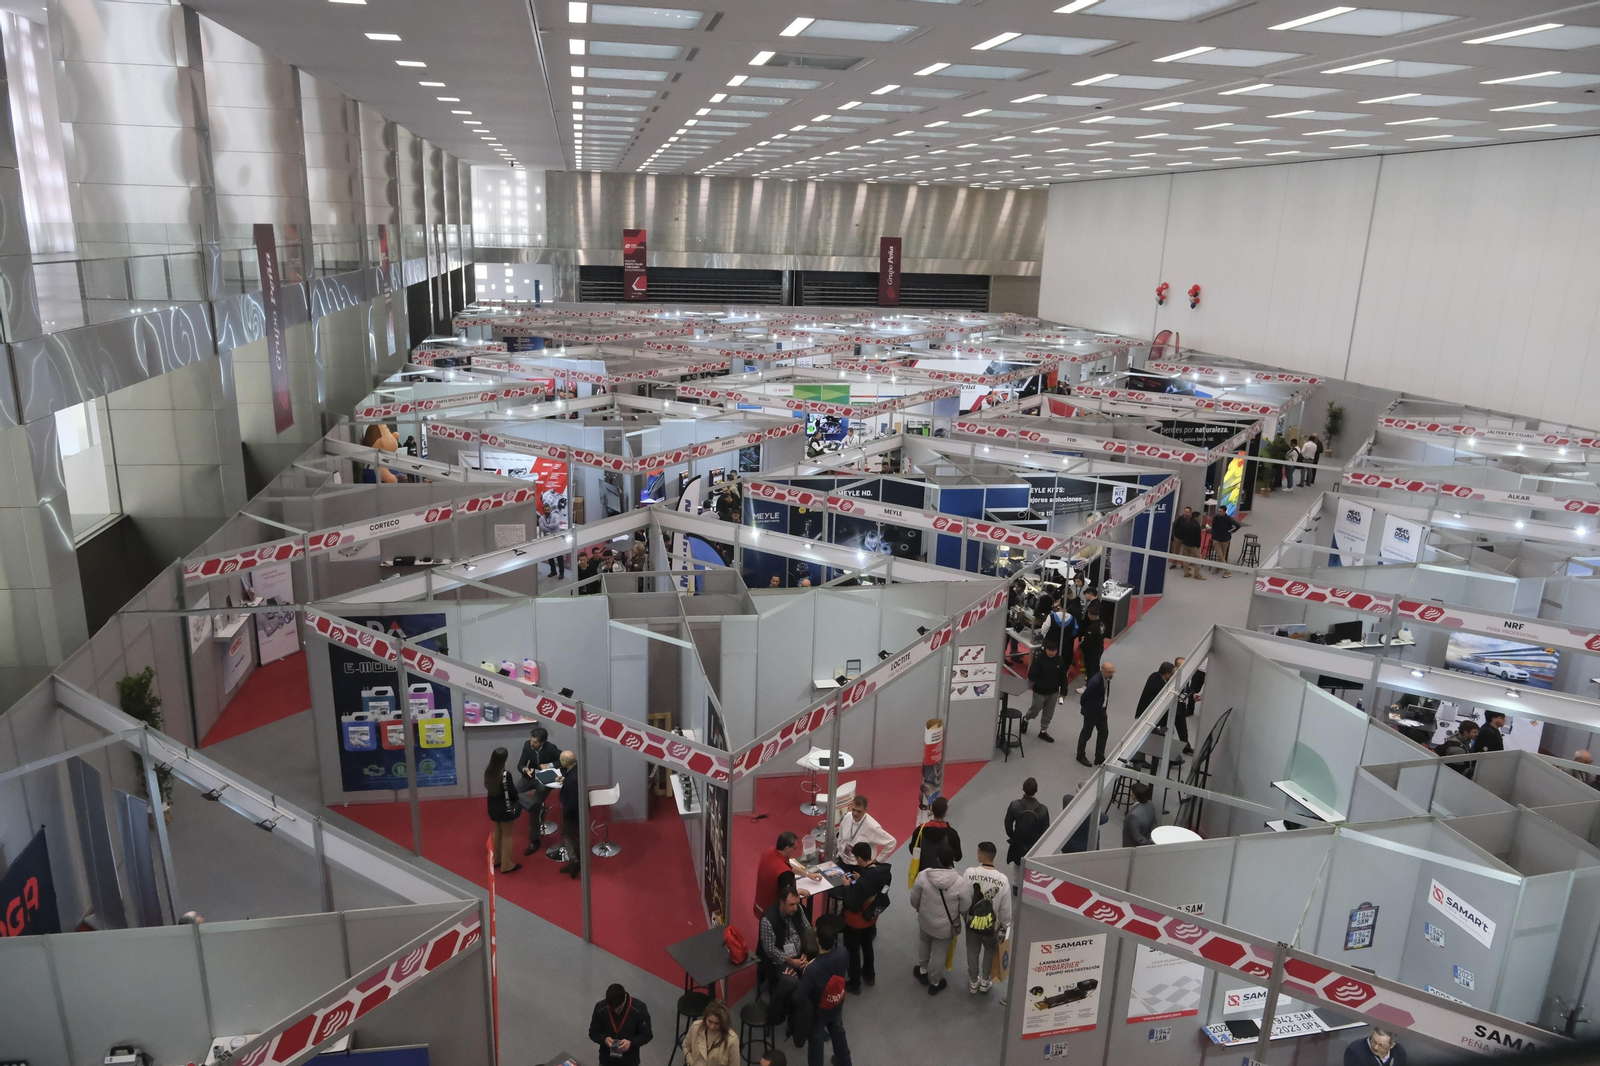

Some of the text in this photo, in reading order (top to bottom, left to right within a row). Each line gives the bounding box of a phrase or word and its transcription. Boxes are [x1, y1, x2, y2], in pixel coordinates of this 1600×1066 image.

[266, 252, 282, 370] Grupo Peña
[503, 439, 527, 448] TECNODIESEL
[370, 519, 399, 531] CORTECO
[1504, 621, 1525, 630] NRF
[1502, 629, 1539, 639] PROFESIONAL
[344, 661, 397, 673] E-MOB
[891, 652, 910, 671] LOCTITE
[474, 675, 494, 689] IADA
[969, 875, 1004, 887] MUTATION
[1186, 904, 1203, 913] SAM
[1430, 926, 1444, 938] 1942
[1430, 932, 1440, 942] SAM
[1054, 939, 1094, 950] SAMAR't
[1038, 961, 1080, 972] BOMBARDIER
[1064, 965, 1100, 974] MULTIESTACIÓN
[1458, 968, 1473, 982] 2023
[1458, 977, 1470, 987] SAM
[1243, 991, 1267, 1001] SAM
[1294, 1012, 1314, 1022] SAM
[1210, 1025, 1229, 1034] 202
[1276, 1020, 1322, 1035] 2023 GPA
[1474, 1024, 1546, 1051] SAMA
[1051, 1043, 1068, 1051] 1942
[1461, 1036, 1490, 1052] PEÑA
